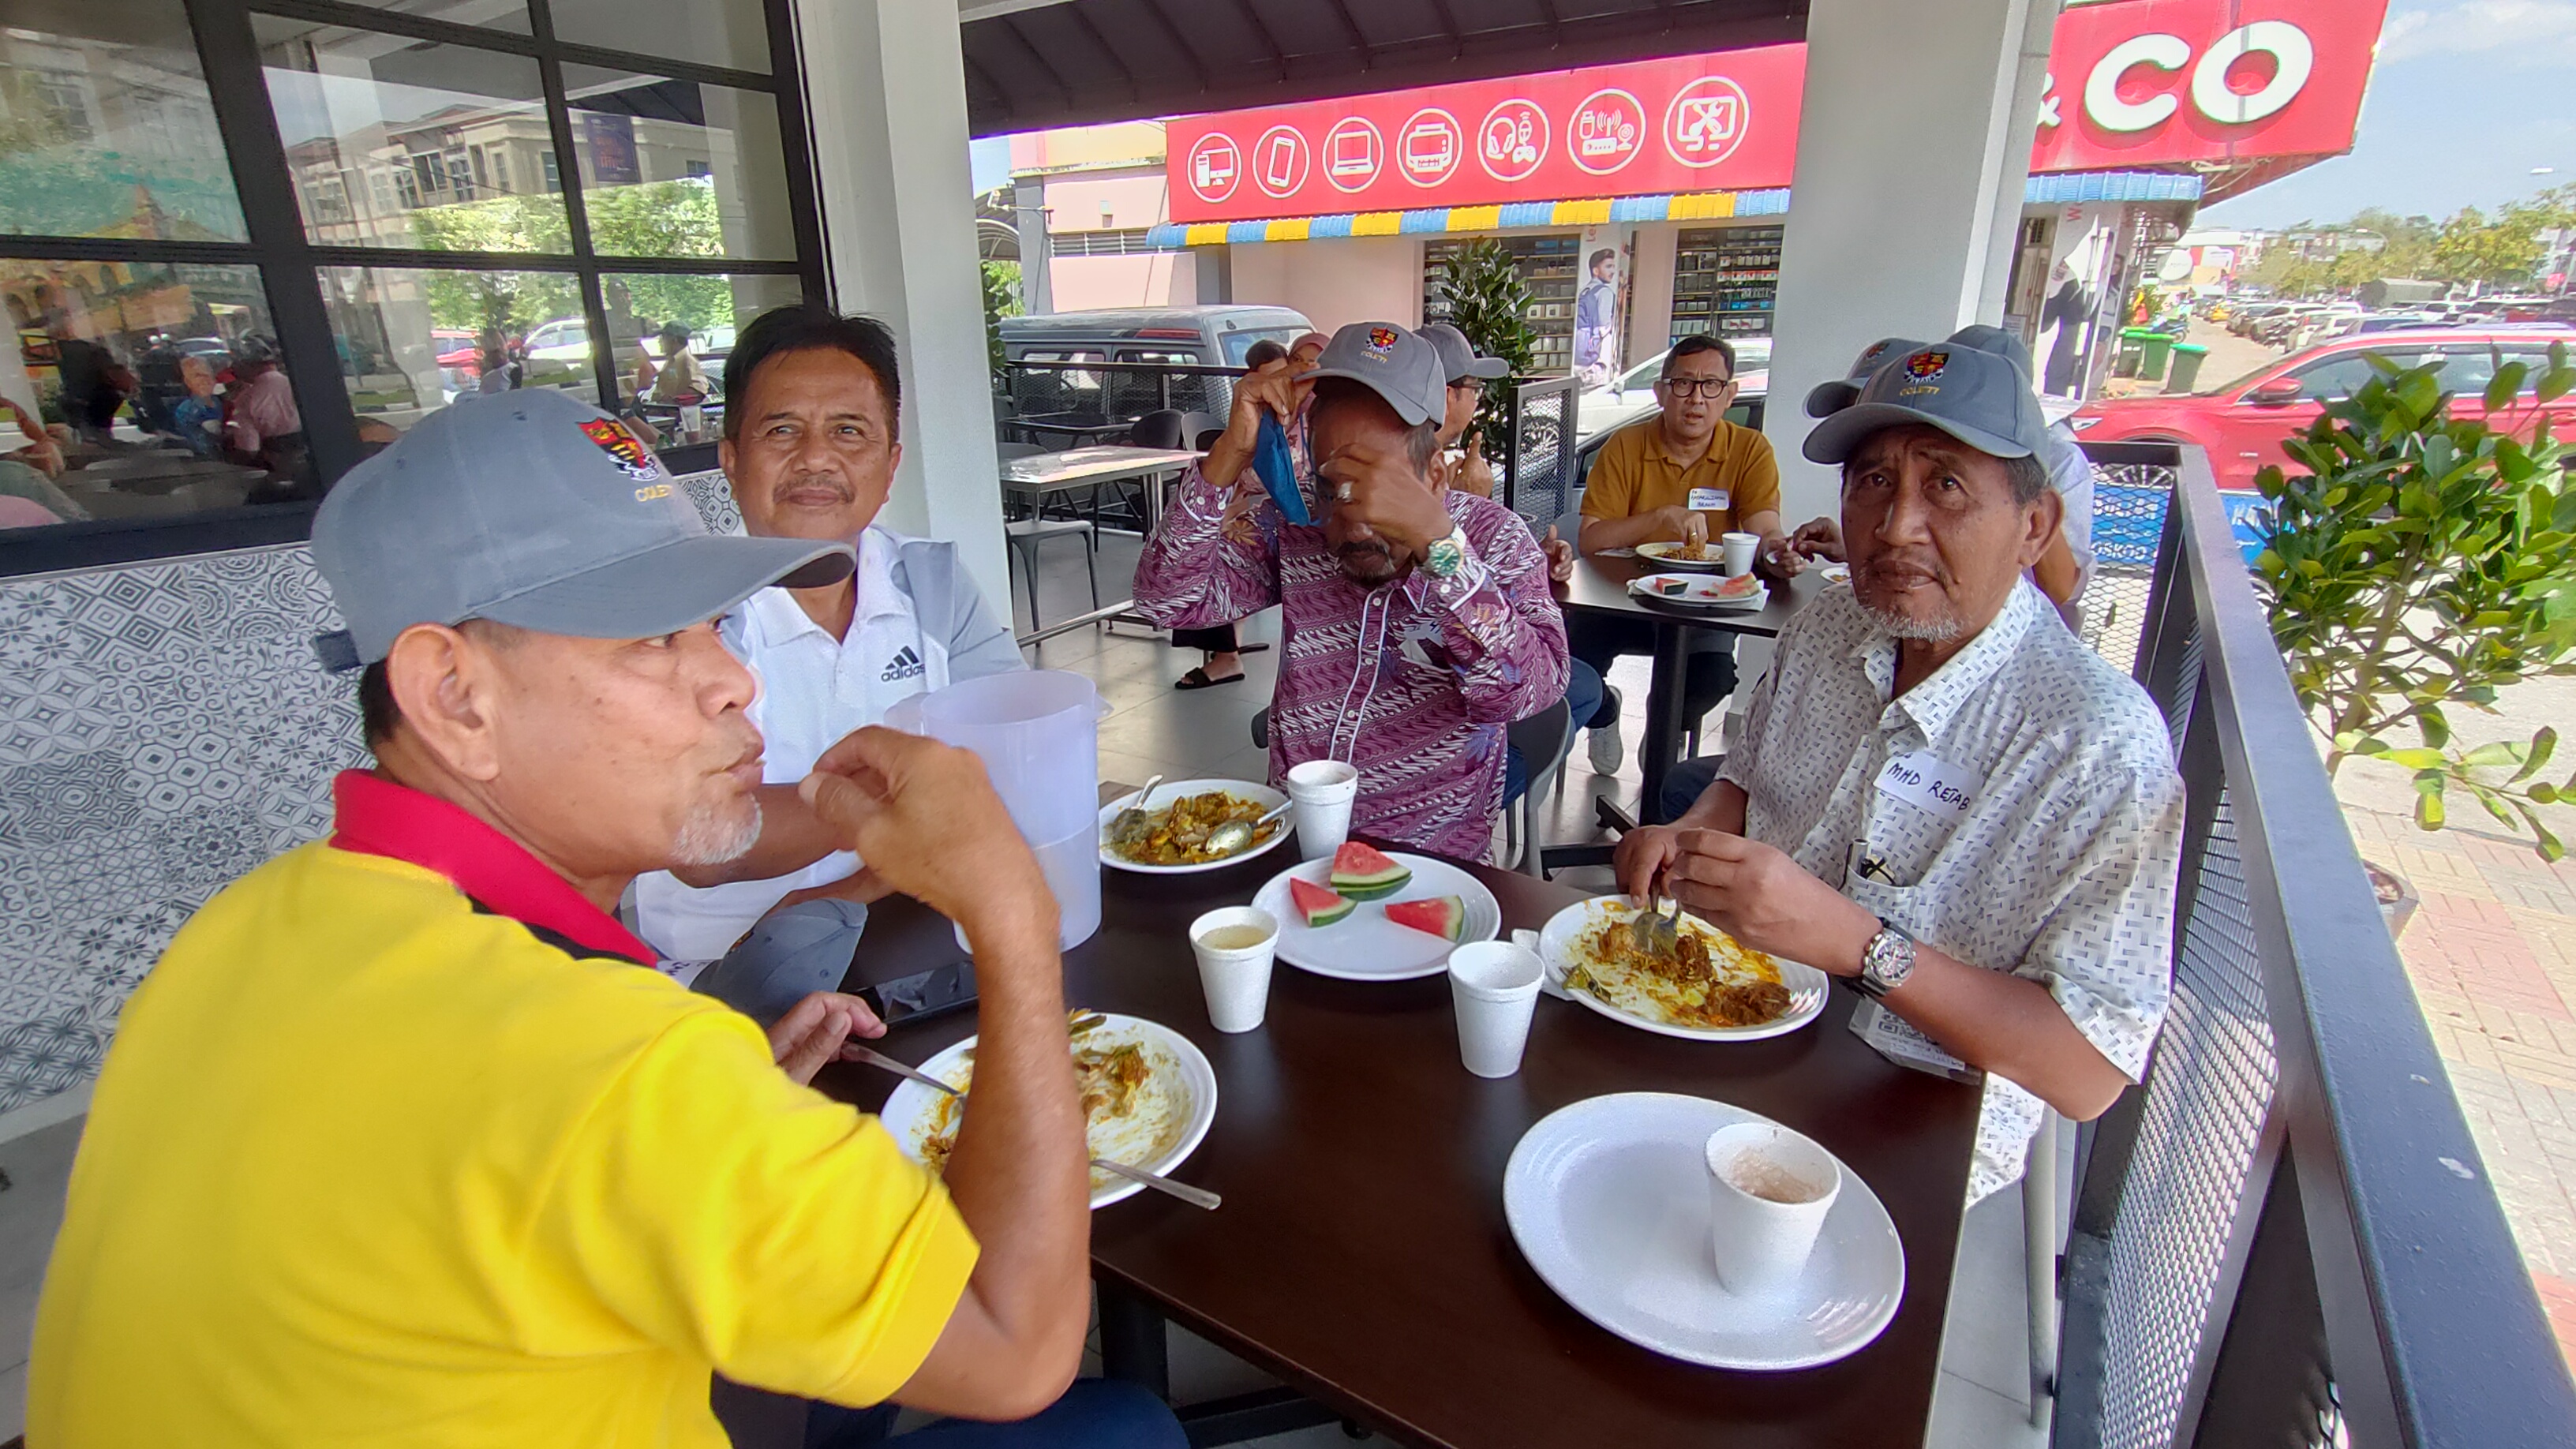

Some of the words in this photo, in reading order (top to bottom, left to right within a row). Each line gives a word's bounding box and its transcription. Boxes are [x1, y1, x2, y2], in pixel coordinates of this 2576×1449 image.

[2084, 21, 2313, 132] CO
[881, 663, 926, 682] adidas
[1886, 762, 1921, 785] MHD
[1927, 781, 1971, 811] REJAB
